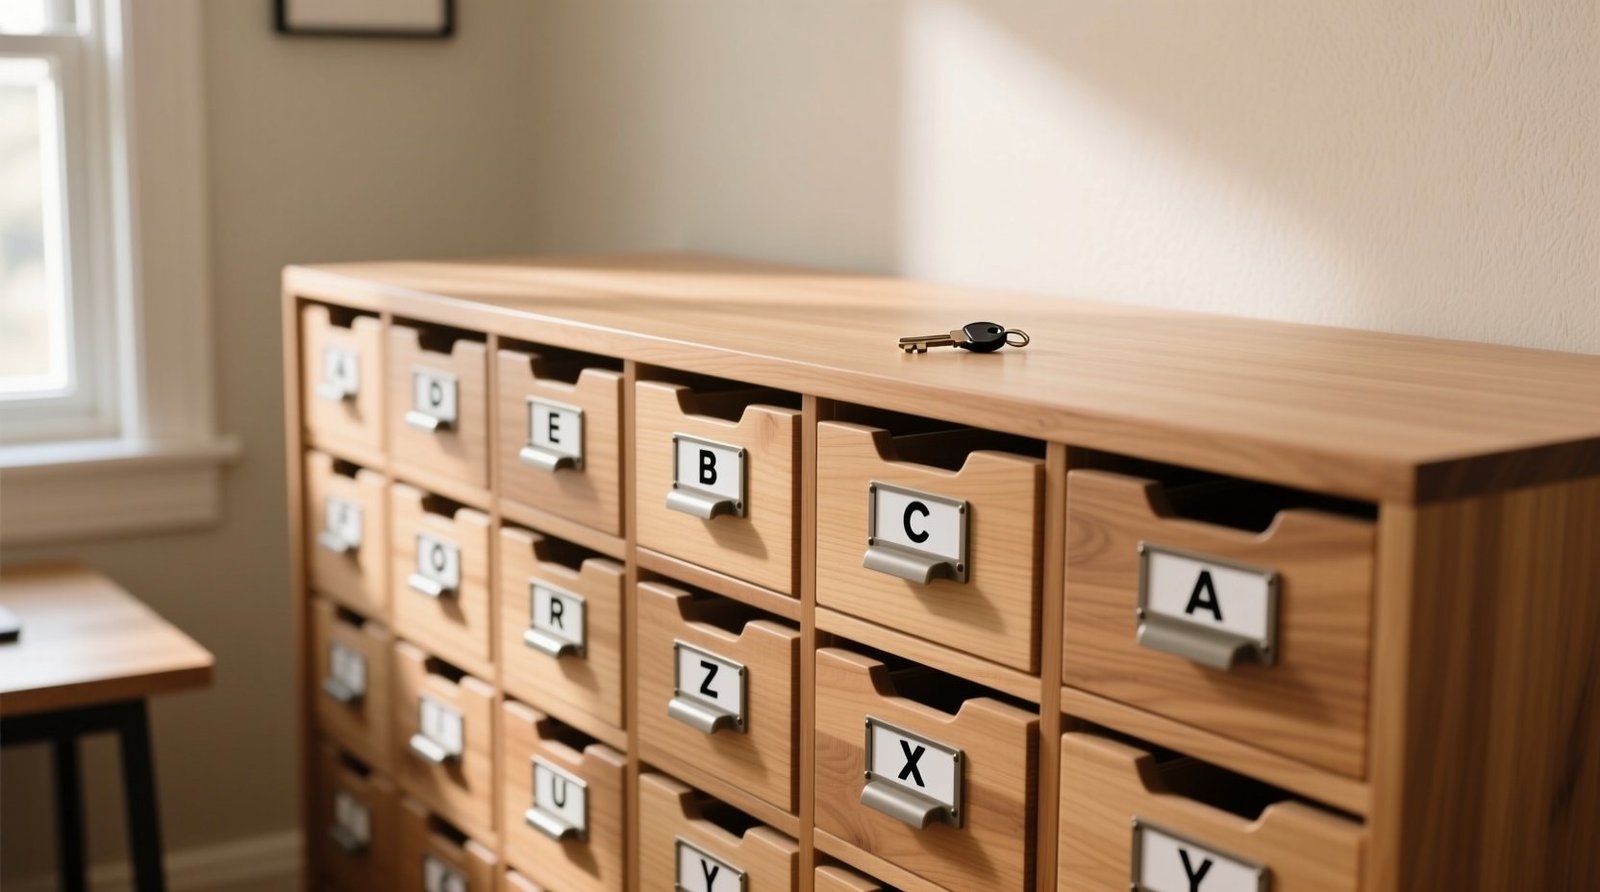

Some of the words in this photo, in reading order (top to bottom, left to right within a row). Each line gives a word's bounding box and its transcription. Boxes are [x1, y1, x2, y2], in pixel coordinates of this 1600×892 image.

[548, 411, 560, 443] E
[699, 448, 718, 486] B
[903, 500, 930, 544] C
[550, 596, 564, 629] R
[1185, 570, 1223, 622] A
[699, 660, 719, 699] Z
[897, 739, 926, 788] X
[552, 773, 569, 810] U
[700, 859, 720, 892] Y
[1178, 848, 1213, 892] Y
